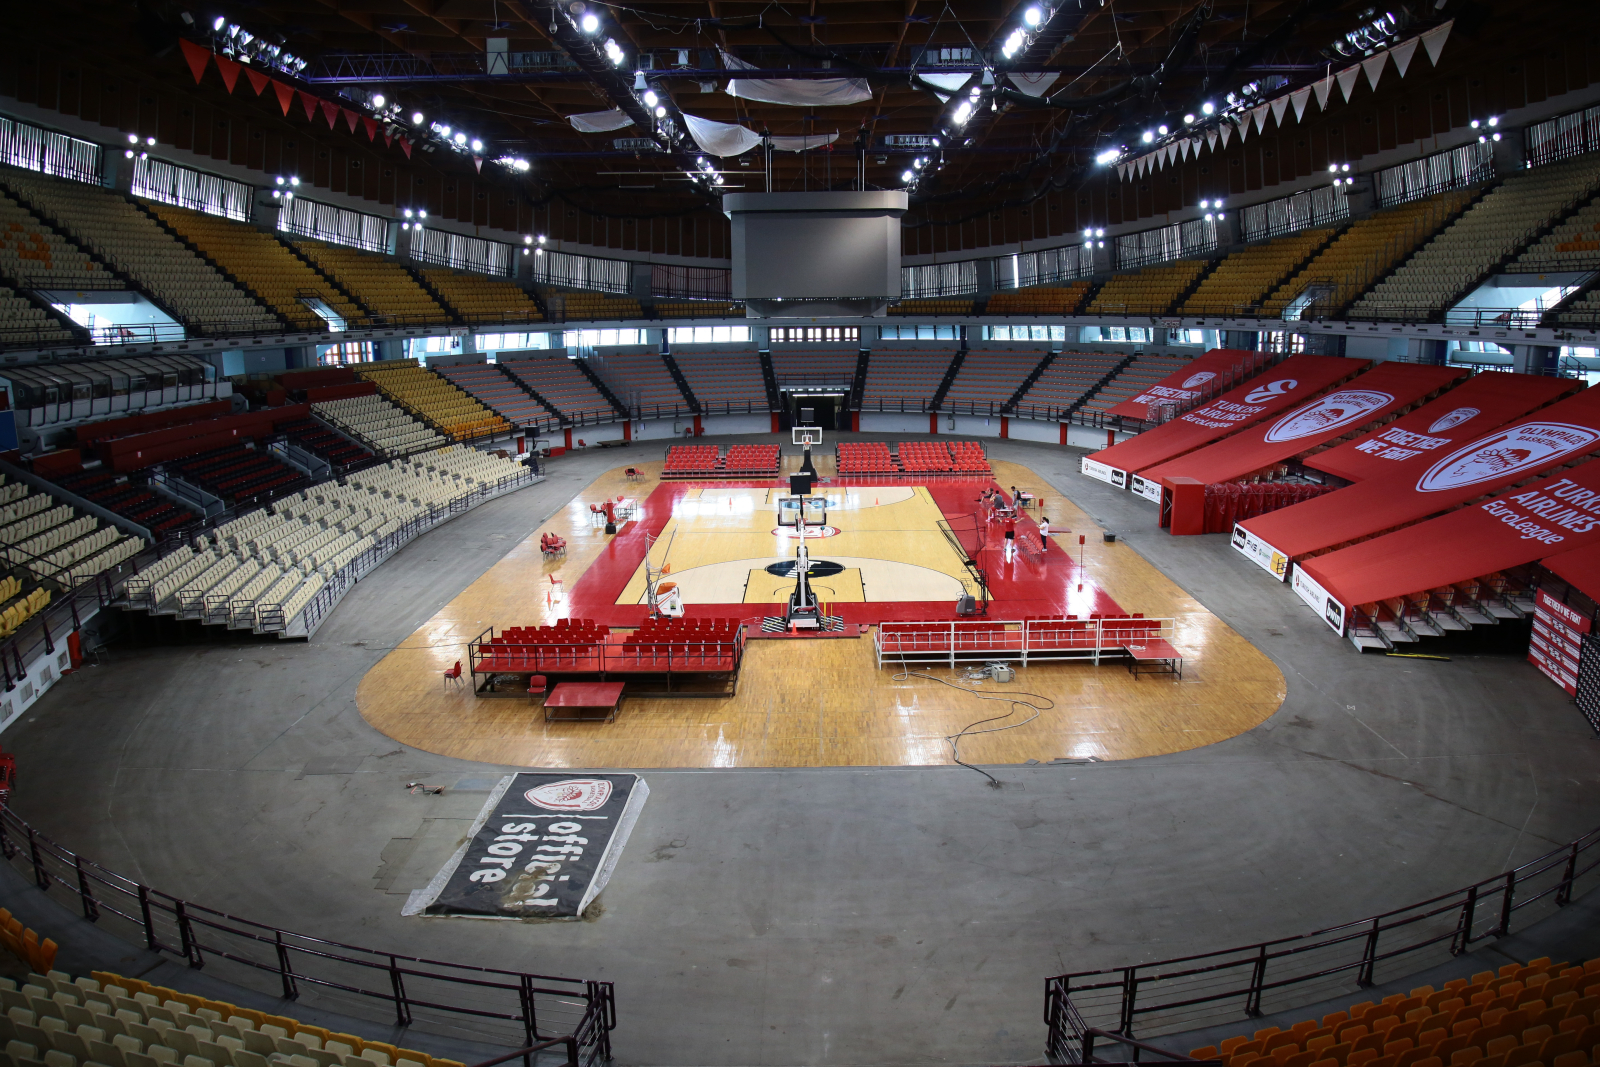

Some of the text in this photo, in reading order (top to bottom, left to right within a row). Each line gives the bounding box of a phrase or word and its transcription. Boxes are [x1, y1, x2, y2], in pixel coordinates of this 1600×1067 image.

[1146, 385, 1202, 400] TOGETHER
[1332, 393, 1384, 406] OLYMPIACOS
[1212, 399, 1267, 414] TURKISH
[1332, 399, 1367, 409] BASKETBALL
[1181, 413, 1234, 430] EuroLeague
[1195, 408, 1251, 421] AIRLINES
[1378, 426, 1452, 450] TOGETHER
[1516, 434, 1564, 450] BASKETBALL
[1518, 426, 1587, 445] OLYMPIACOS
[1354, 438, 1424, 461] WE FIGHT
[1509, 490, 1600, 533] AIRLINES
[1481, 499, 1565, 545] EuroLeague
[1326, 602, 1341, 627] bwin
[469, 822, 539, 883] store
[503, 821, 589, 908] official
